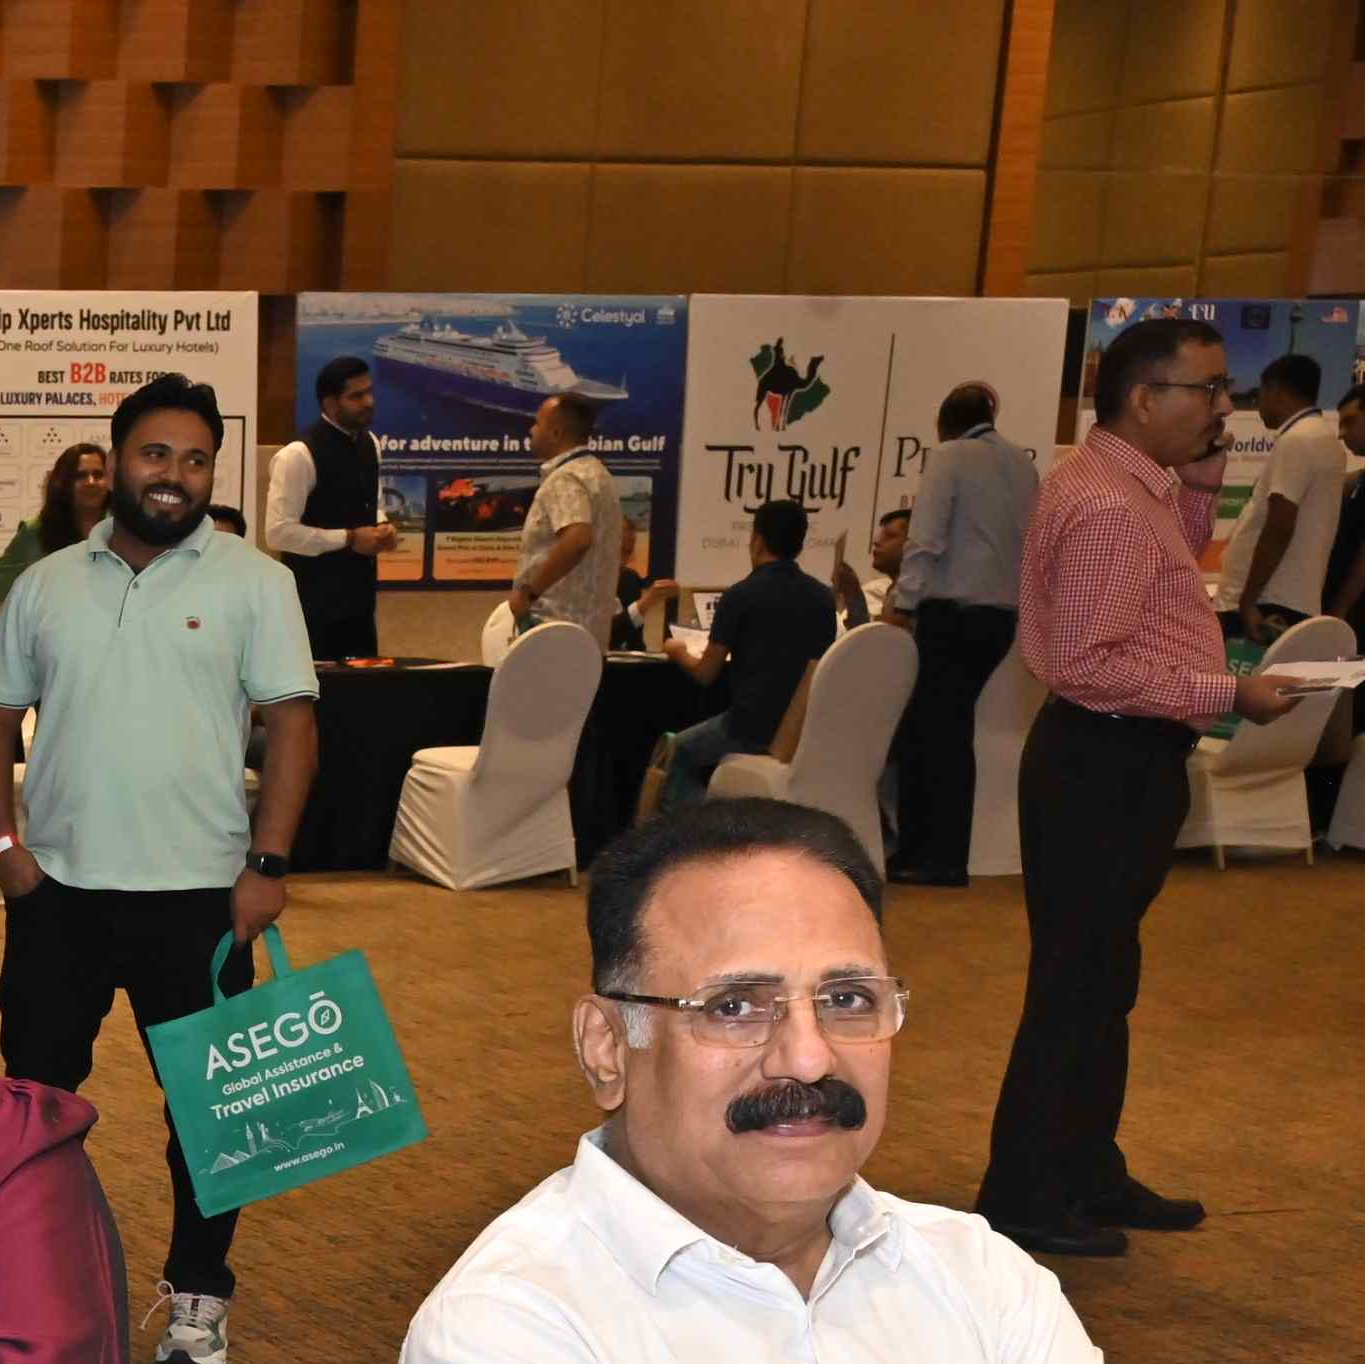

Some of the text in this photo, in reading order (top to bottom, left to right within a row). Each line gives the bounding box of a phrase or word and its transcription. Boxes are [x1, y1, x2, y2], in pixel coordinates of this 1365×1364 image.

[18, 308, 74, 334] Xperts
[79, 308, 168, 335] Hospitality
[174, 310, 201, 332] Pvt
[207, 310, 231, 332] Ltd
[580, 307, 646, 327] Celestyal
[25, 340, 54, 352] Roof
[56, 340, 107, 352] Solution
[109, 340, 129, 352] For
[133, 341, 173, 355] Luxury
[176, 341, 220, 355] Hotels)
[38, 370, 65, 384] BEST
[70, 362, 107, 384] B2B
[109, 370, 143, 384] RATES
[0, 392, 130, 407] LUXURY PALACES, HOTE
[380, 434, 407, 452] for
[409, 434, 500, 452] adventure
[504, 434, 521, 452] in
[587, 434, 667, 452] bian Gulf
[705, 443, 774, 514] Try
[777, 443, 861, 514] Gulf
[221, 1042, 344, 1097] Global Assistance &
[210, 1053, 365, 1120] Travel Insurance
[274, 1140, 345, 1172] www.asego.in
